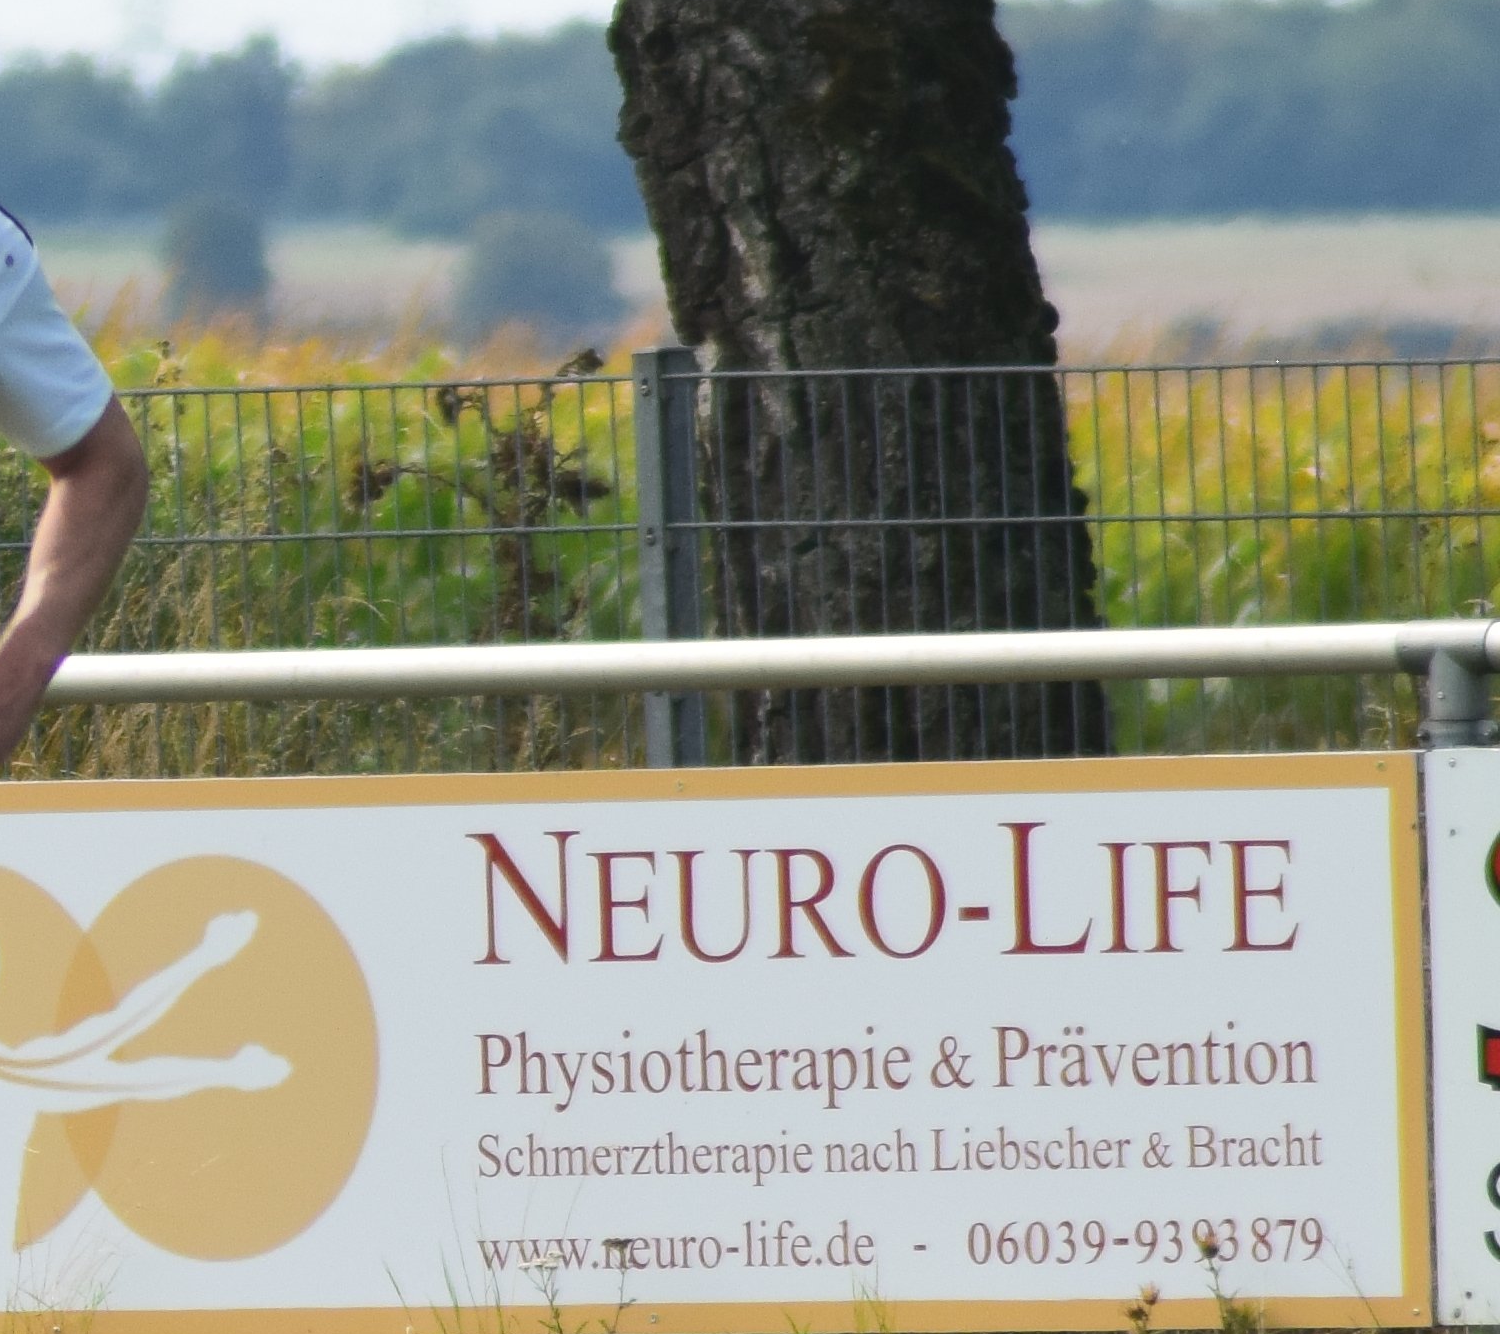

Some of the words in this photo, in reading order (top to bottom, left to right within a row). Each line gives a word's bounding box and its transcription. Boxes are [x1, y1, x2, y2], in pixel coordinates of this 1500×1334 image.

[465, 821, 1300, 966] NEURO-LIFE
[474, 1024, 912, 1112] Physiotherapie
[929, 1035, 974, 1089] &
[992, 1020, 1318, 1090] Prävention
[477, 1129, 814, 1187] Schmerztherapie
[823, 1128, 918, 1174] nach
[930, 1125, 1131, 1172] Liebscher
[1141, 1131, 1173, 1169] &
[1186, 1123, 1324, 1169] Bracht
[477, 1219, 875, 1271] www.neuro-life.de
